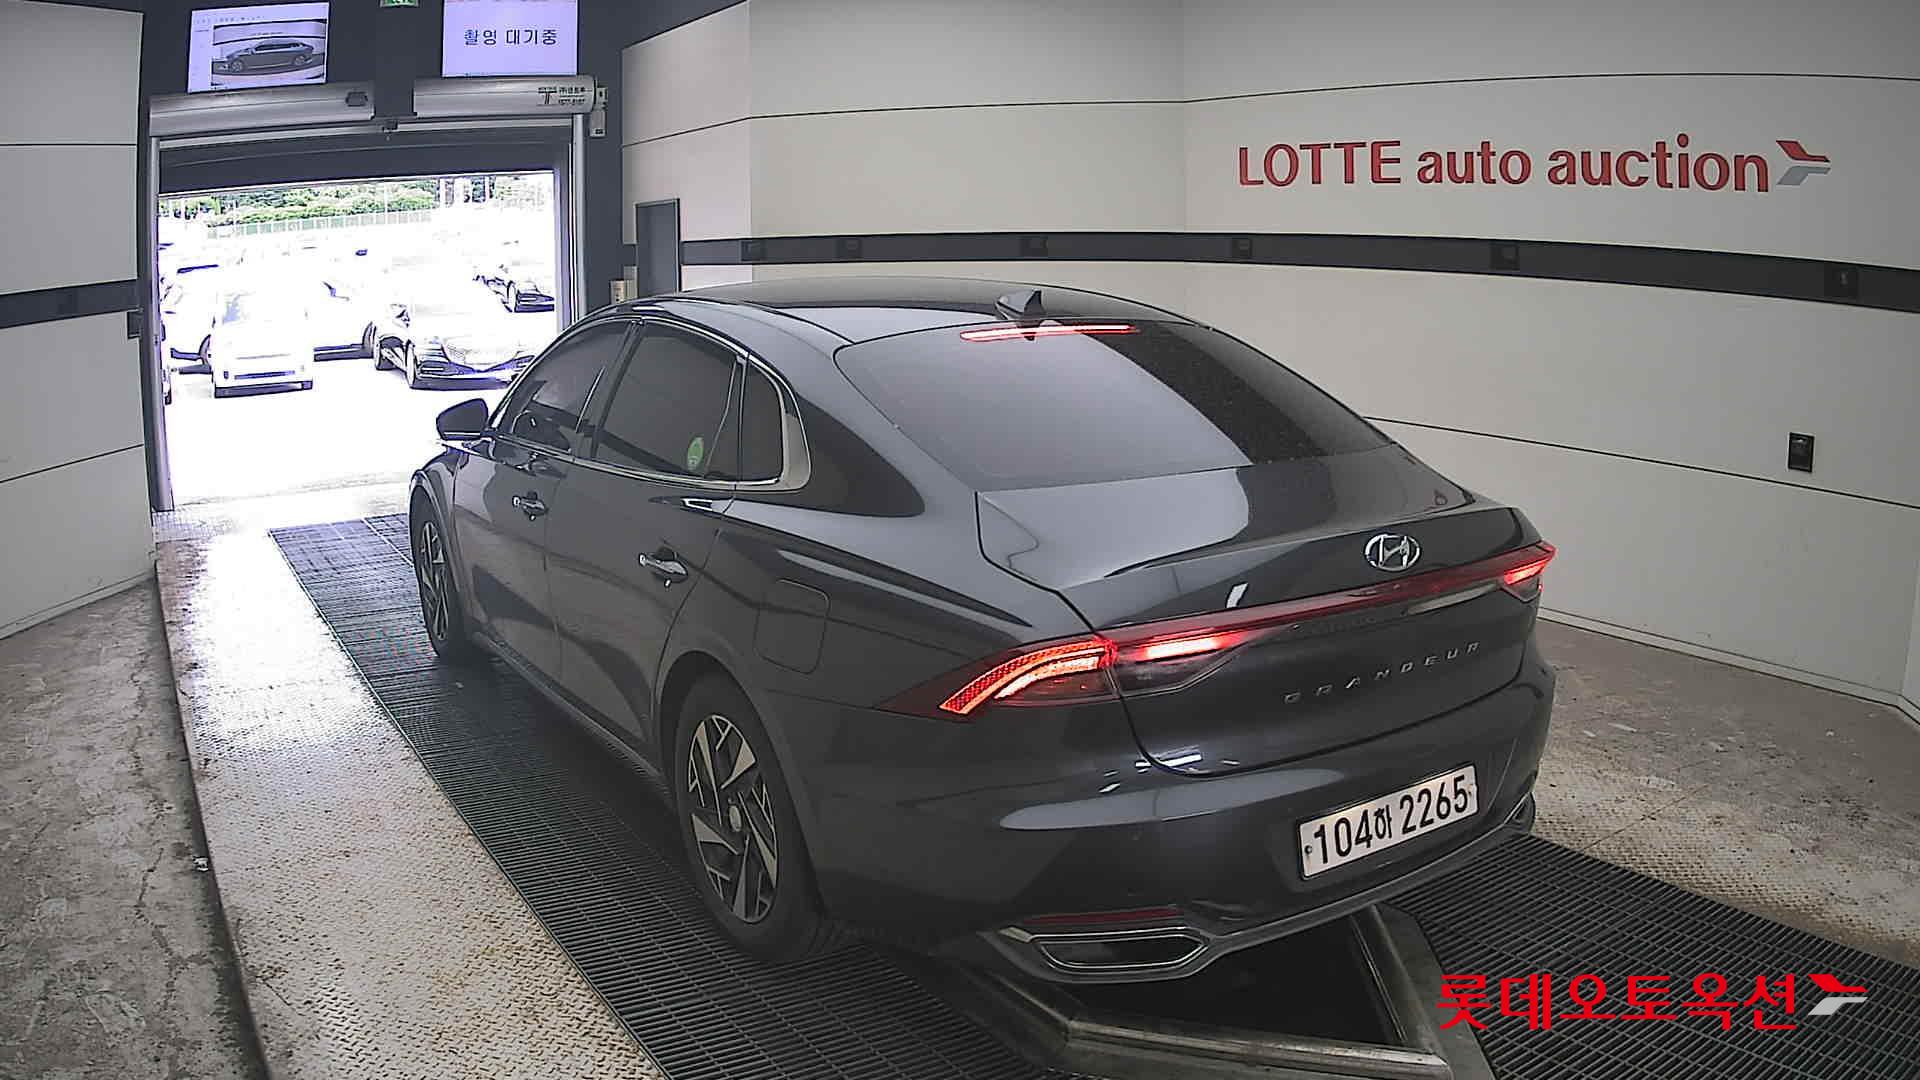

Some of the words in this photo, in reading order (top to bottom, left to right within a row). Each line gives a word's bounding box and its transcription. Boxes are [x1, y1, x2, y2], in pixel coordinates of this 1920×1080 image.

[505, 29, 558, 46] 대기중
[1238, 140, 1401, 187] LOTTE
[1416, 140, 1532, 186] auto
[1547, 132, 1770, 193] auction
[1283, 641, 1480, 704] GRANDEUR
[1313, 804, 1393, 865] 104하
[1399, 774, 1469, 836] 2265
